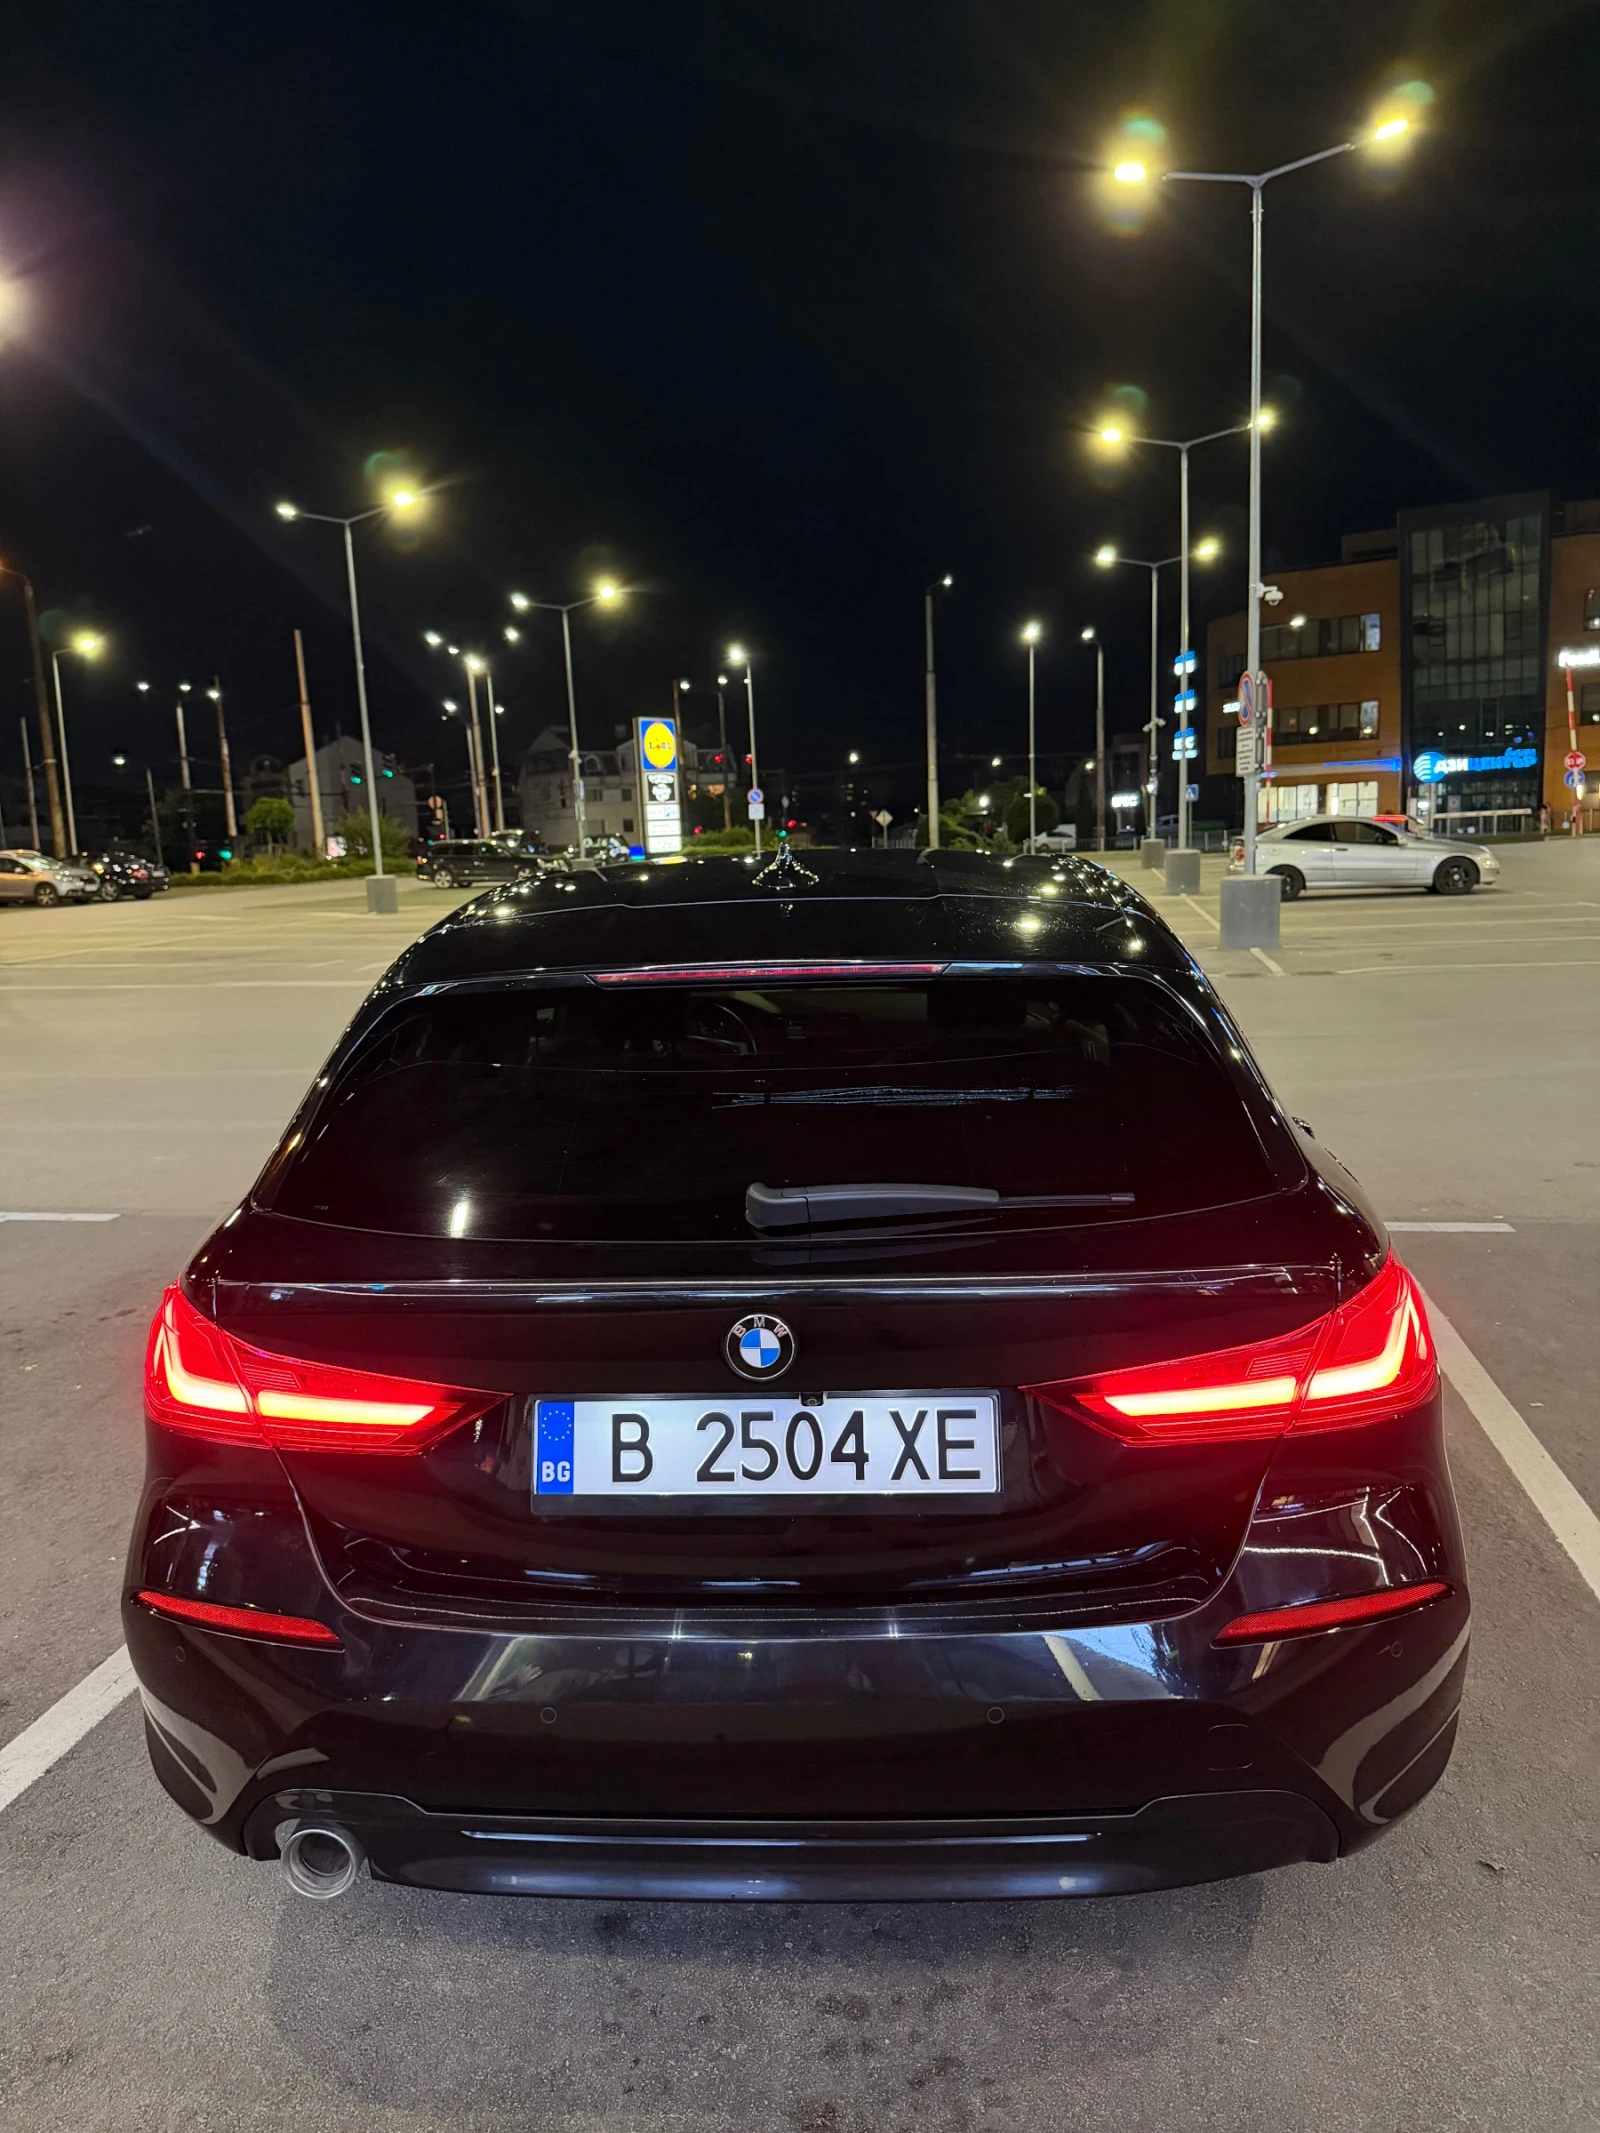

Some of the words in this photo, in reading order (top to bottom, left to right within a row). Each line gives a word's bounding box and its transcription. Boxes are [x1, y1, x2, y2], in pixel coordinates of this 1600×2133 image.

[732, 1316, 788, 1339] BMW
[612, 1413, 653, 1483] B
[696, 1410, 870, 1482] 2504
[888, 1409, 981, 1481] XE
[541, 1461, 571, 1482] BG
